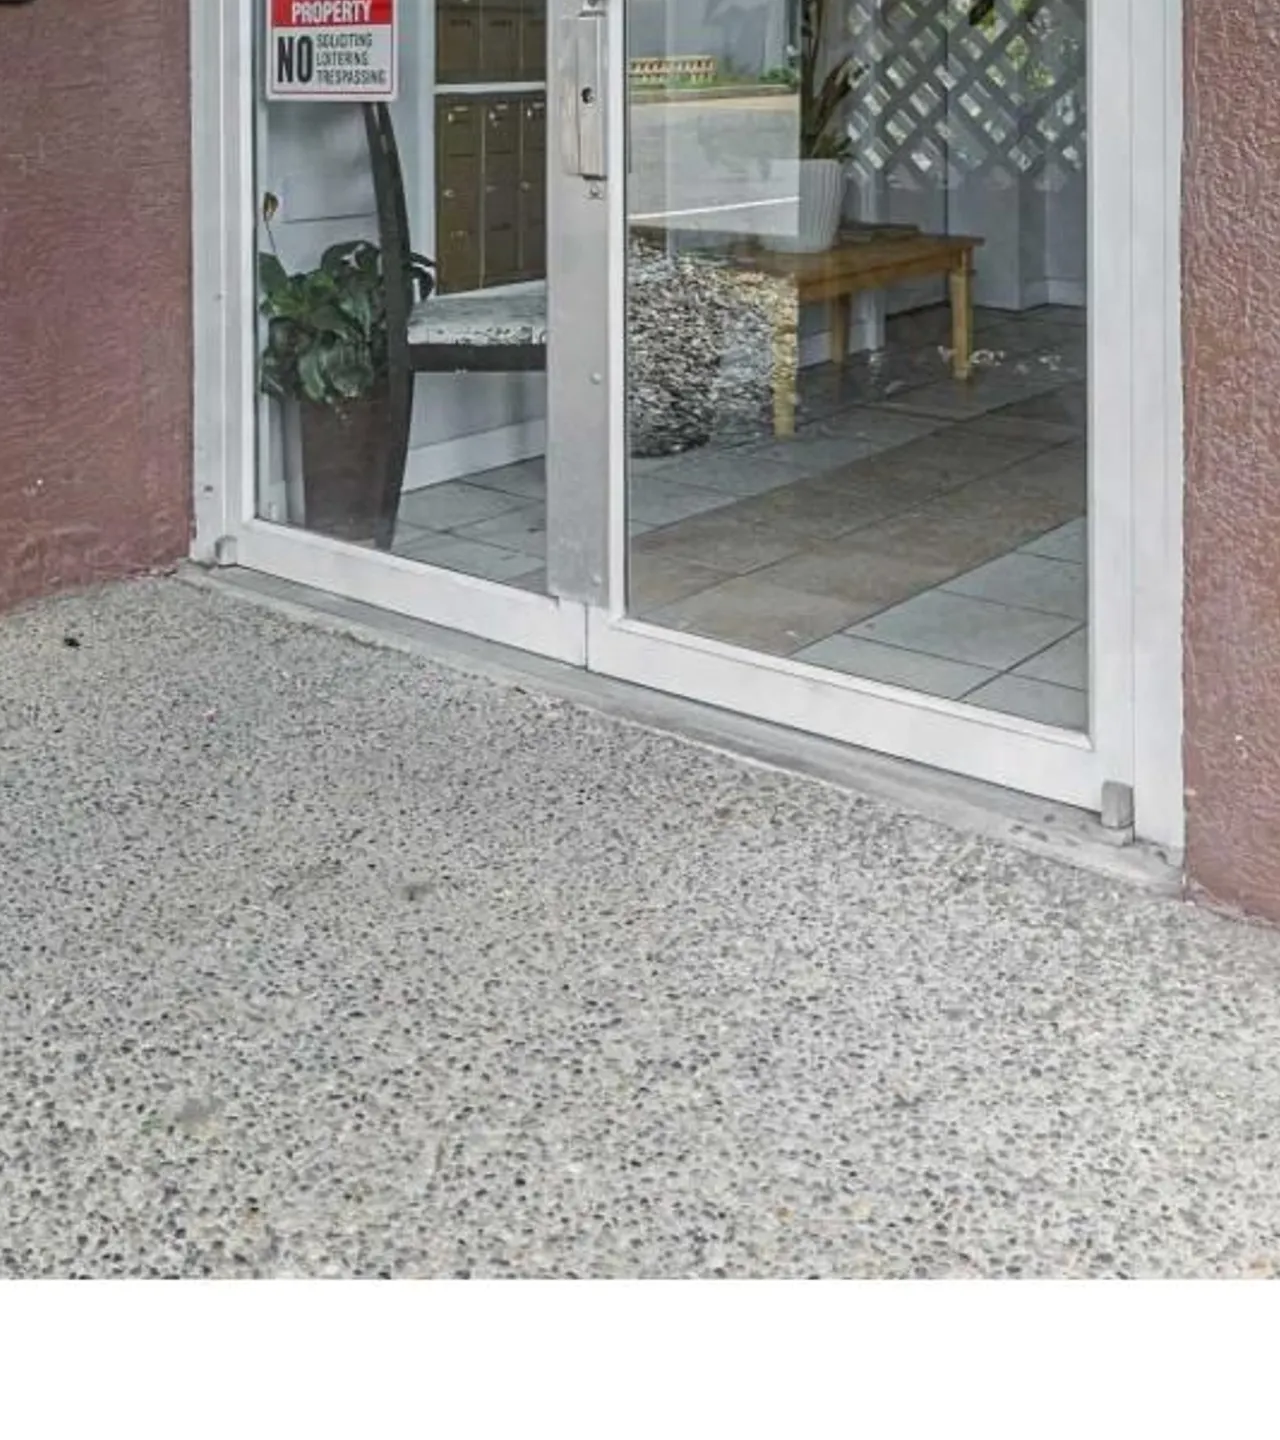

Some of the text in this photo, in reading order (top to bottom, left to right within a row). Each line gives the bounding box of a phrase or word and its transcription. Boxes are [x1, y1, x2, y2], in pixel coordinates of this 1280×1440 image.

[291, 0, 373, 24] PROPERTY
[277, 34, 314, 84] NO
[316, 68, 387, 85] TRESPASSING
